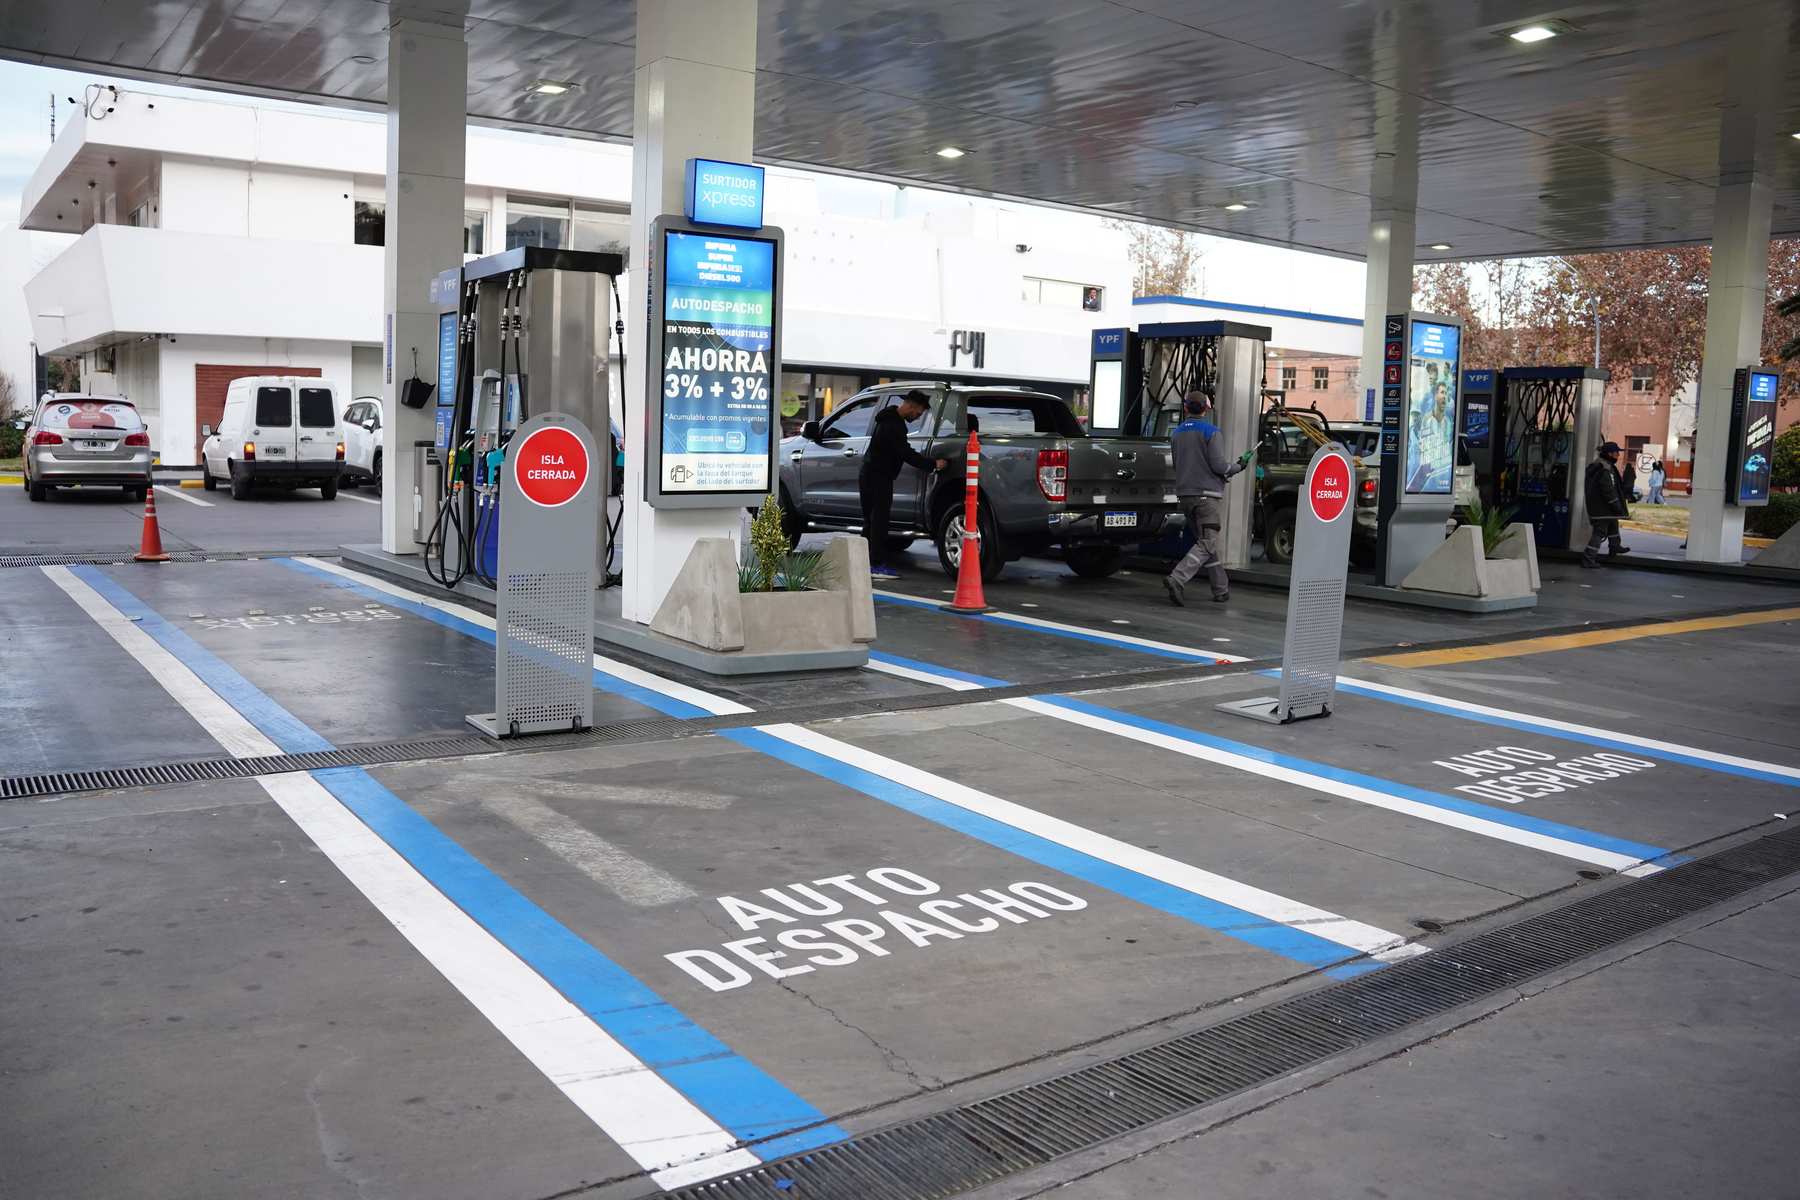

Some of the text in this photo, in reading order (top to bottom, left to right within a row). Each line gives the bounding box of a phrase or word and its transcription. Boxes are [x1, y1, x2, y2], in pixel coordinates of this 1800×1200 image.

[703, 174, 757, 190] SURTIDOR
[702, 190, 756, 208] xpress
[443, 279, 457, 291] YPF
[671, 297, 763, 315] AUTODESPACHO
[667, 325, 769, 339] EN TODOS LOS COMBUSTIBLES
[1099, 335, 1120, 344] YPF
[665, 344, 768, 374] AHORRÁ
[1468, 374, 1489, 382] YPF
[665, 373, 768, 400] 3% + 3%
[541, 455, 564, 465] ISLA
[528, 470, 576, 480] CERRADA
[1324, 477, 1337, 486] ISLA
[1316, 490, 1343, 499] CERRADA
[1432, 746, 1556, 778] AUTO
[1453, 752, 1656, 804] DESPACHO
[716, 867, 940, 931] AUTO
[663, 881, 1088, 992] DESPACHO
